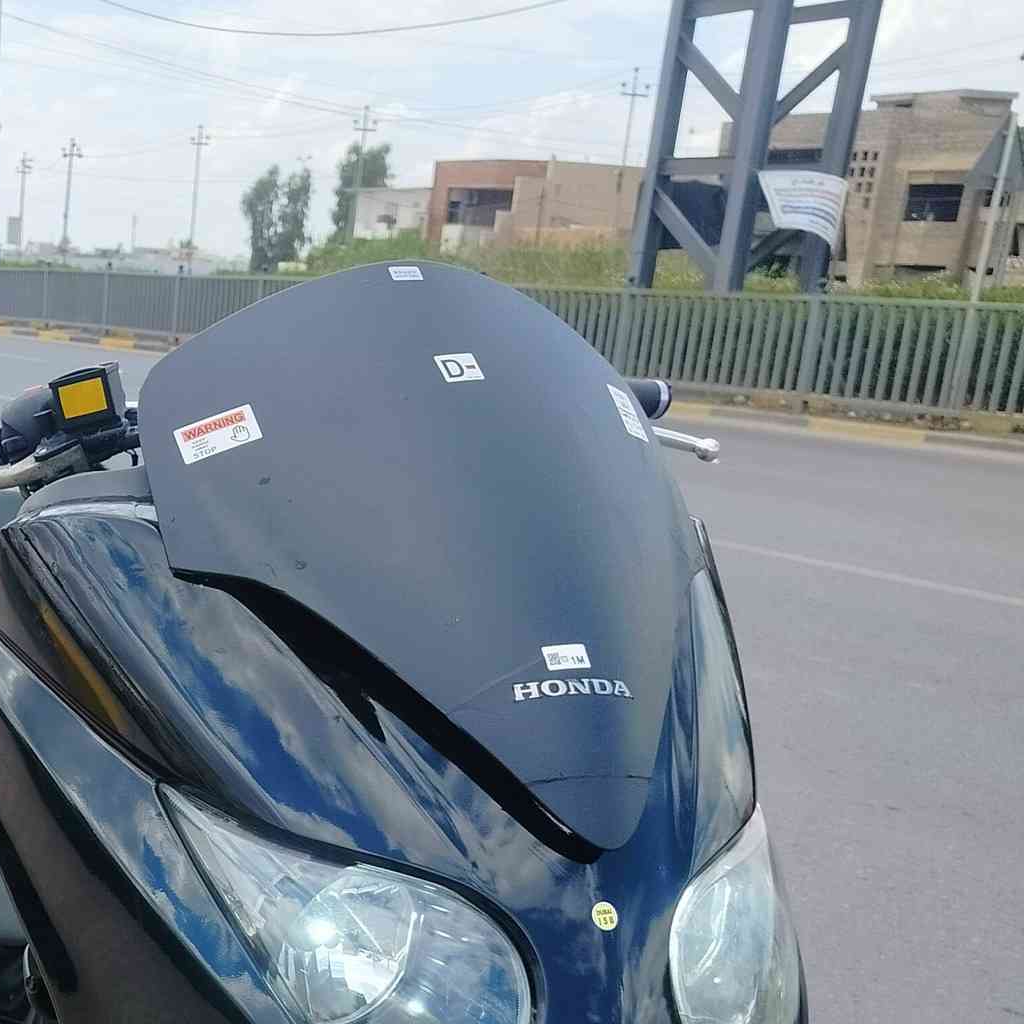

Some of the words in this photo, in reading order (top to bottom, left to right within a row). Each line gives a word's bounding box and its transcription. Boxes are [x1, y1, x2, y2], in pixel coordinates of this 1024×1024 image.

[182, 412, 245, 441] WARNING
[193, 447, 216, 459] STOP
[513, 678, 633, 701] HONDA
